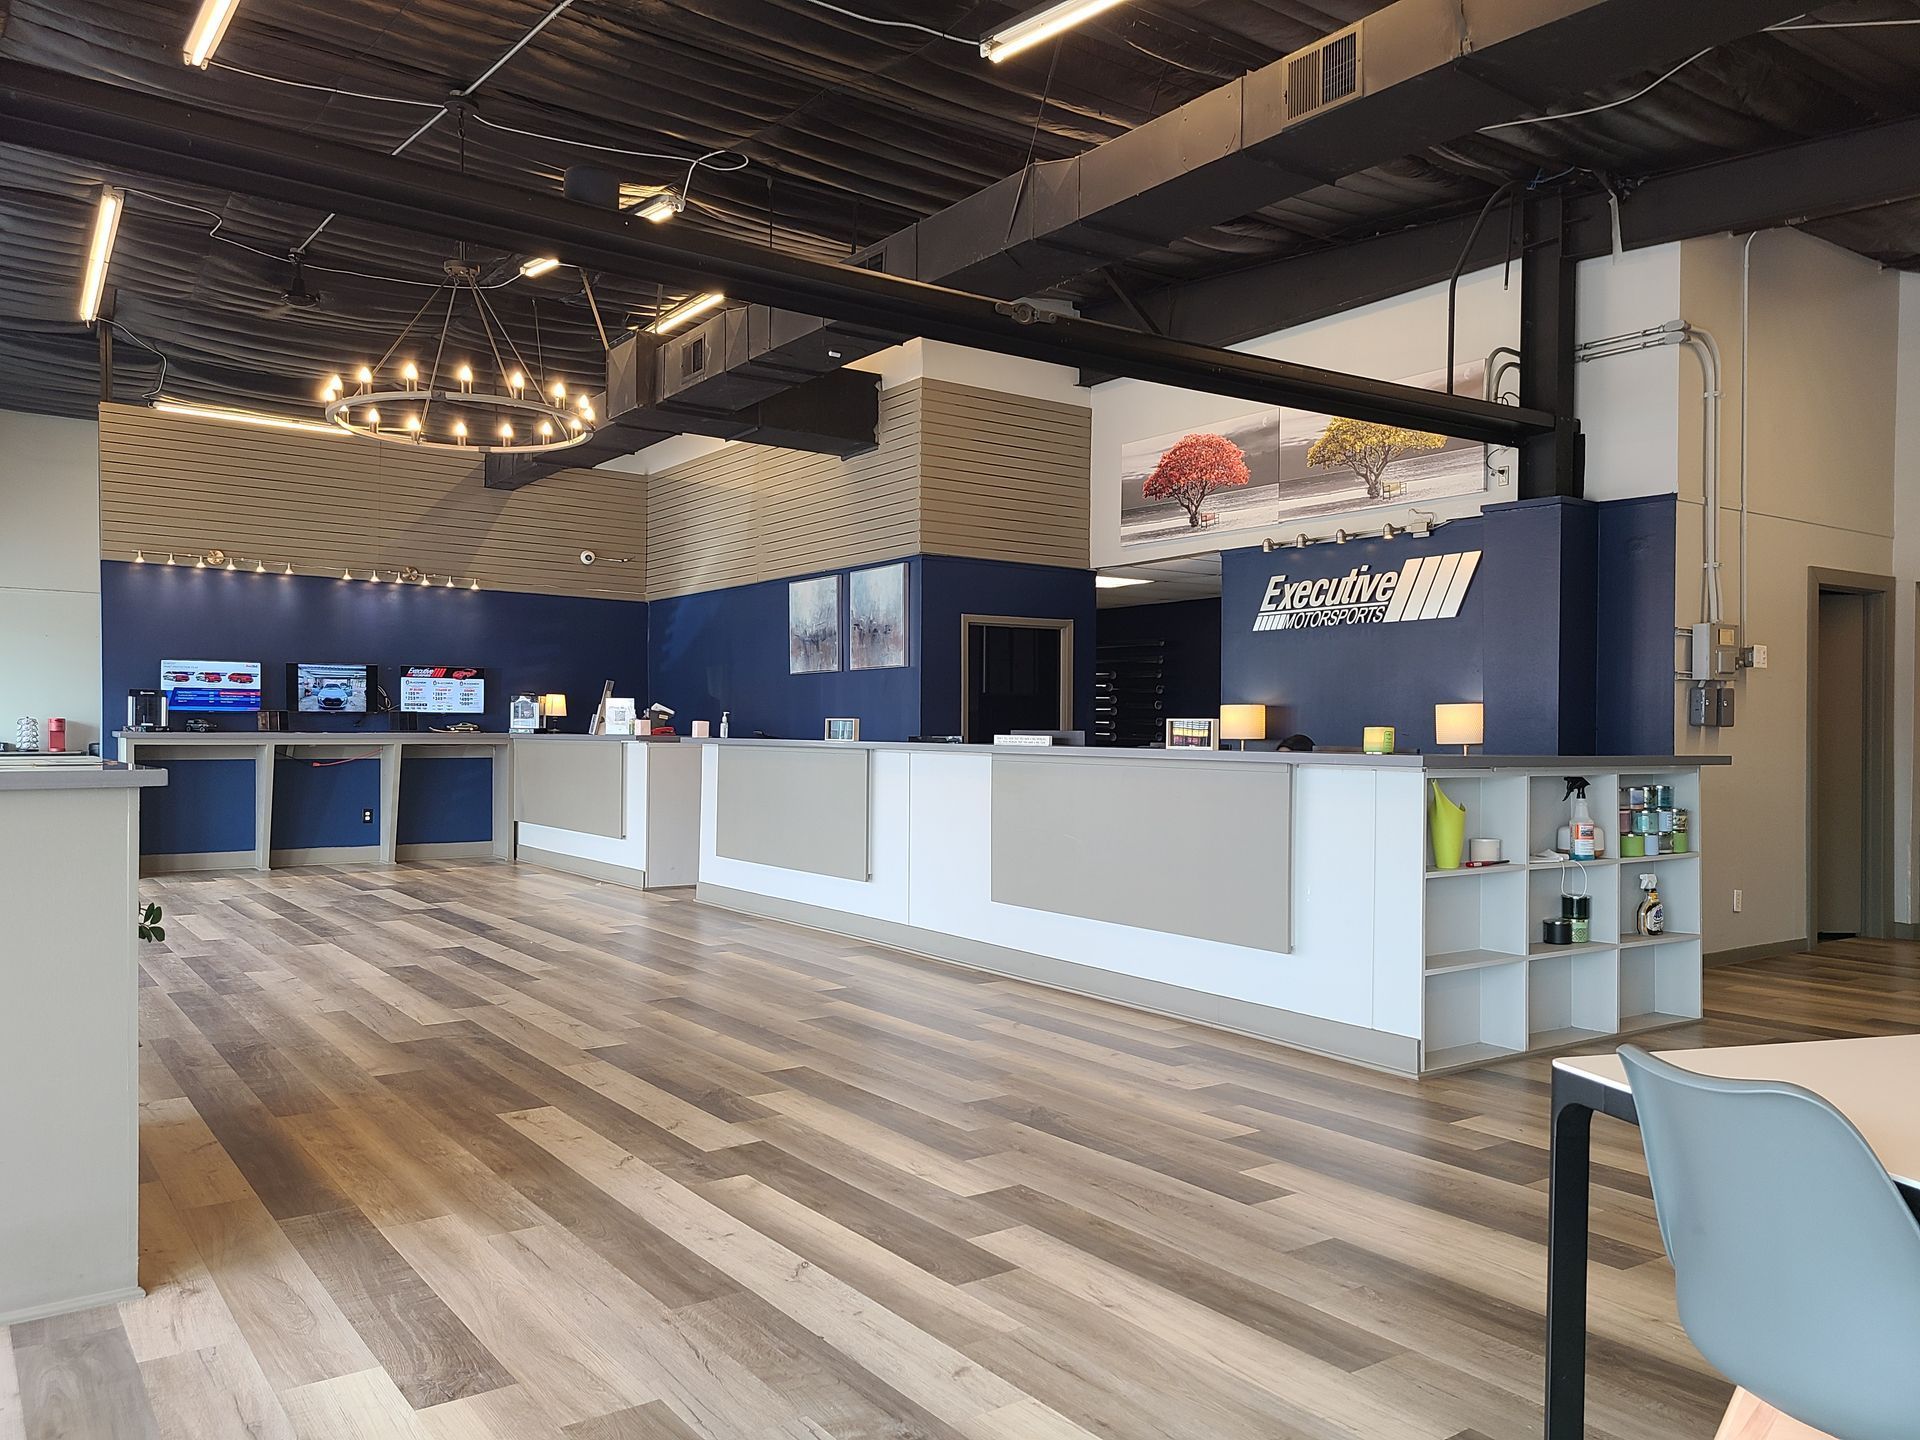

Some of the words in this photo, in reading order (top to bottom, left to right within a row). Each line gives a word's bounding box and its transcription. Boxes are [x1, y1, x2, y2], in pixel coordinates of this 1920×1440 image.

[1259, 564, 1399, 612] Executive
[1282, 605, 1386, 630] MOTORSPORTS
[408, 666, 434, 675] Executive
